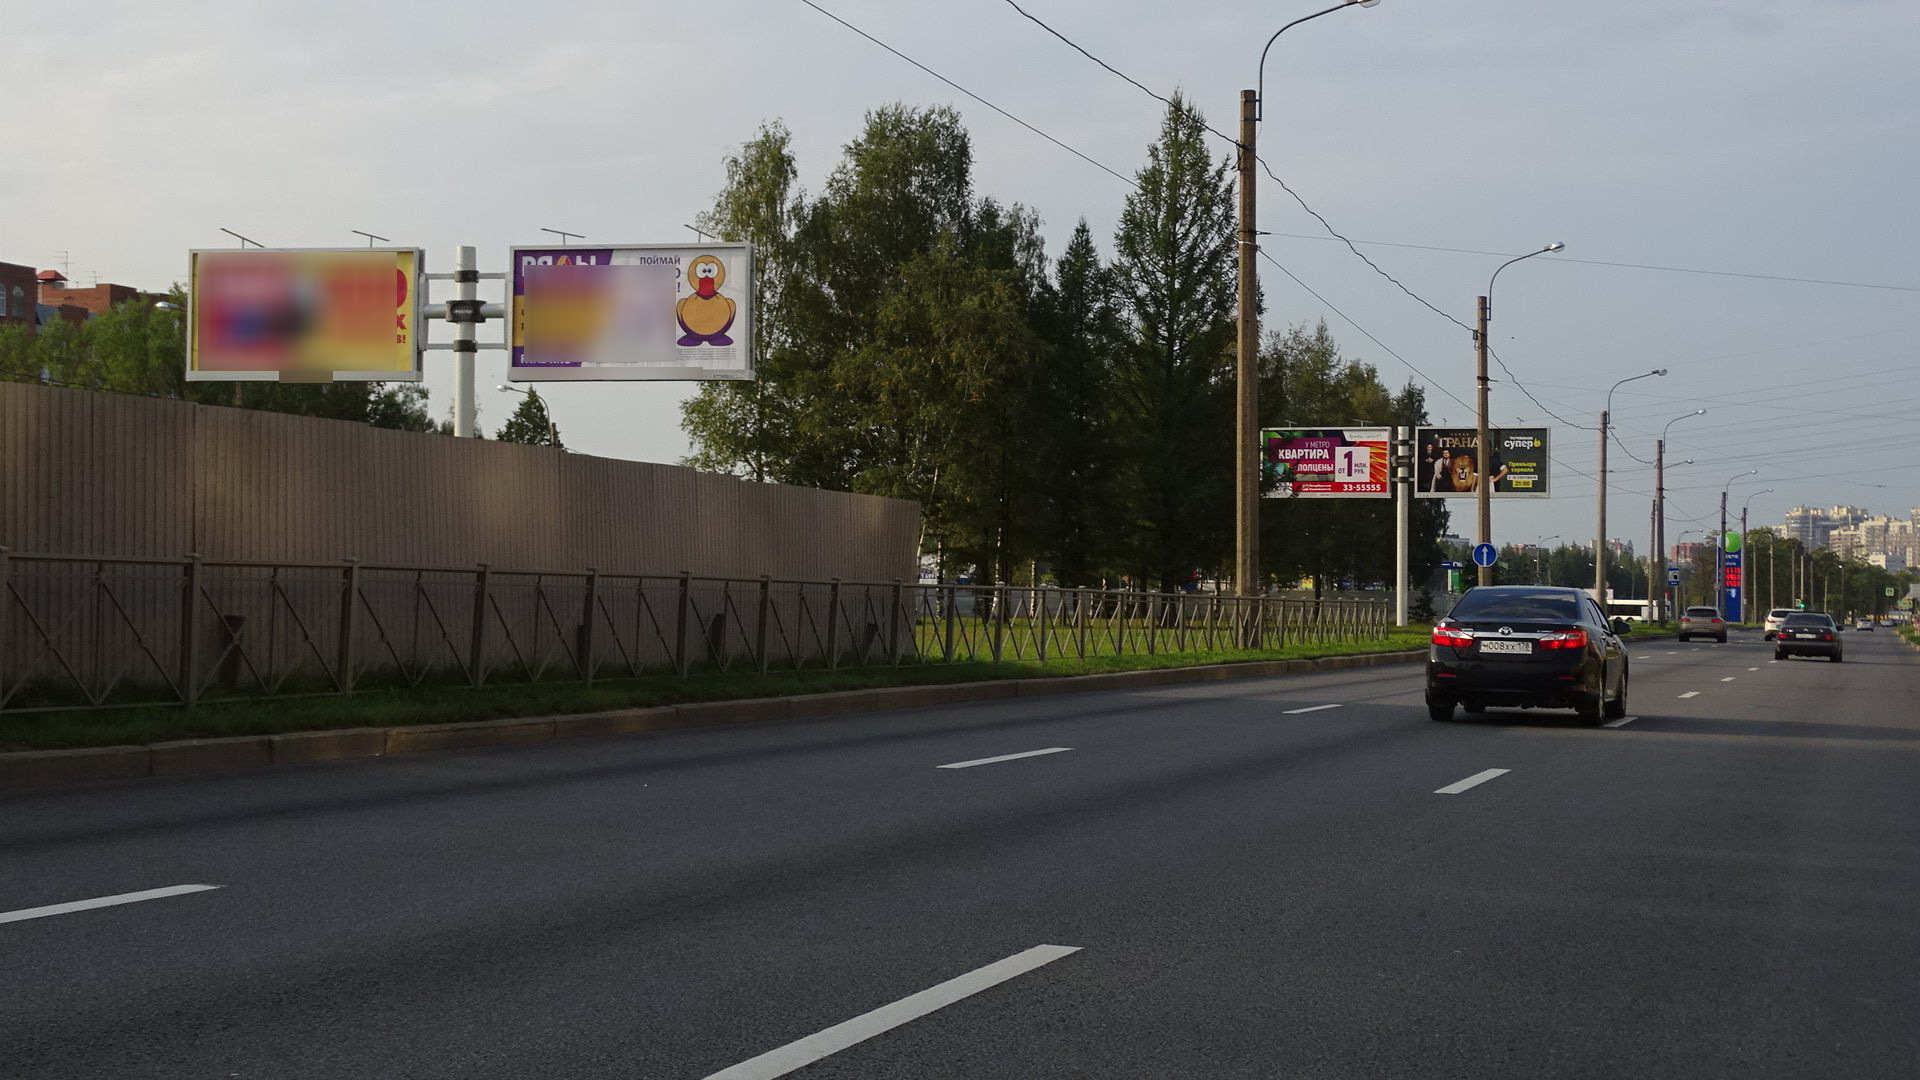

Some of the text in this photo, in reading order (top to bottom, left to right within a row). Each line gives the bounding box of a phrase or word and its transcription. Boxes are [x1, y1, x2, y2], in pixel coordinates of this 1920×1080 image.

[640, 254, 681, 265] ПОЙМАЙ
[1504, 440, 1533, 450] супер
[1278, 449, 1329, 460] КВАРТИРА
[1297, 463, 1334, 472] ПОЛЦЕНЫ
[1344, 451, 1353, 477] 1
[1342, 484, 1381, 492] 33-55555
